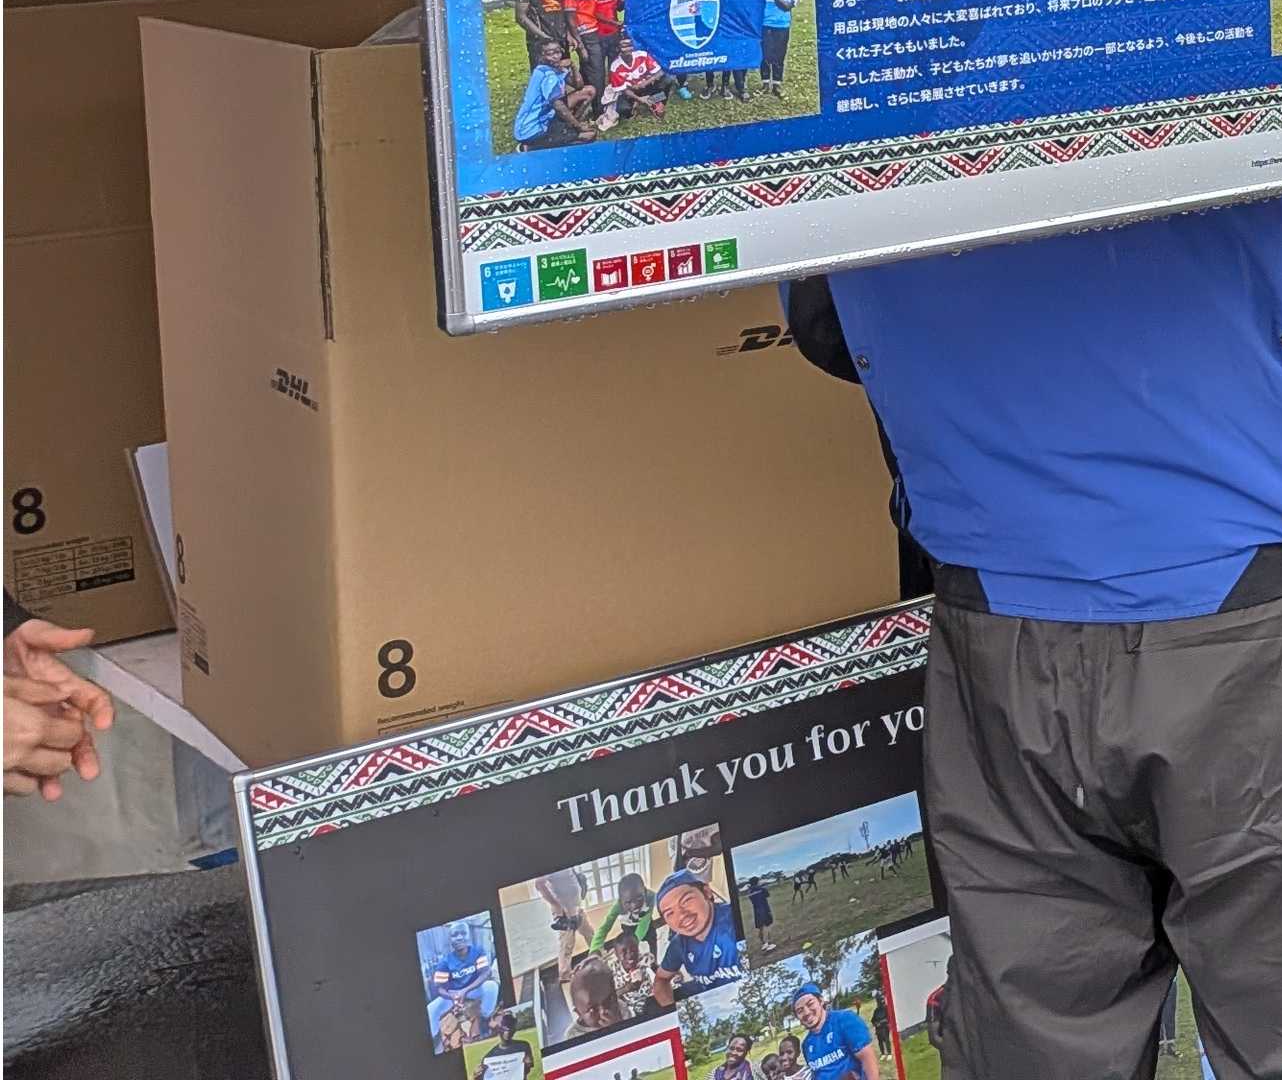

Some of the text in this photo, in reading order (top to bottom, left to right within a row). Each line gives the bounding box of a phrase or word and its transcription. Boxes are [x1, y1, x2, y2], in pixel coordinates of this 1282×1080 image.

[836, 35, 967, 60] くれた子どももいました。
[484, 265, 491, 278] 6
[541, 256, 548, 268] 3
[12, 487, 47, 535] 8
[377, 639, 417, 698] 8
[558, 763, 707, 834] Thank
[716, 733, 796, 796] you
[806, 712, 865, 768] for
